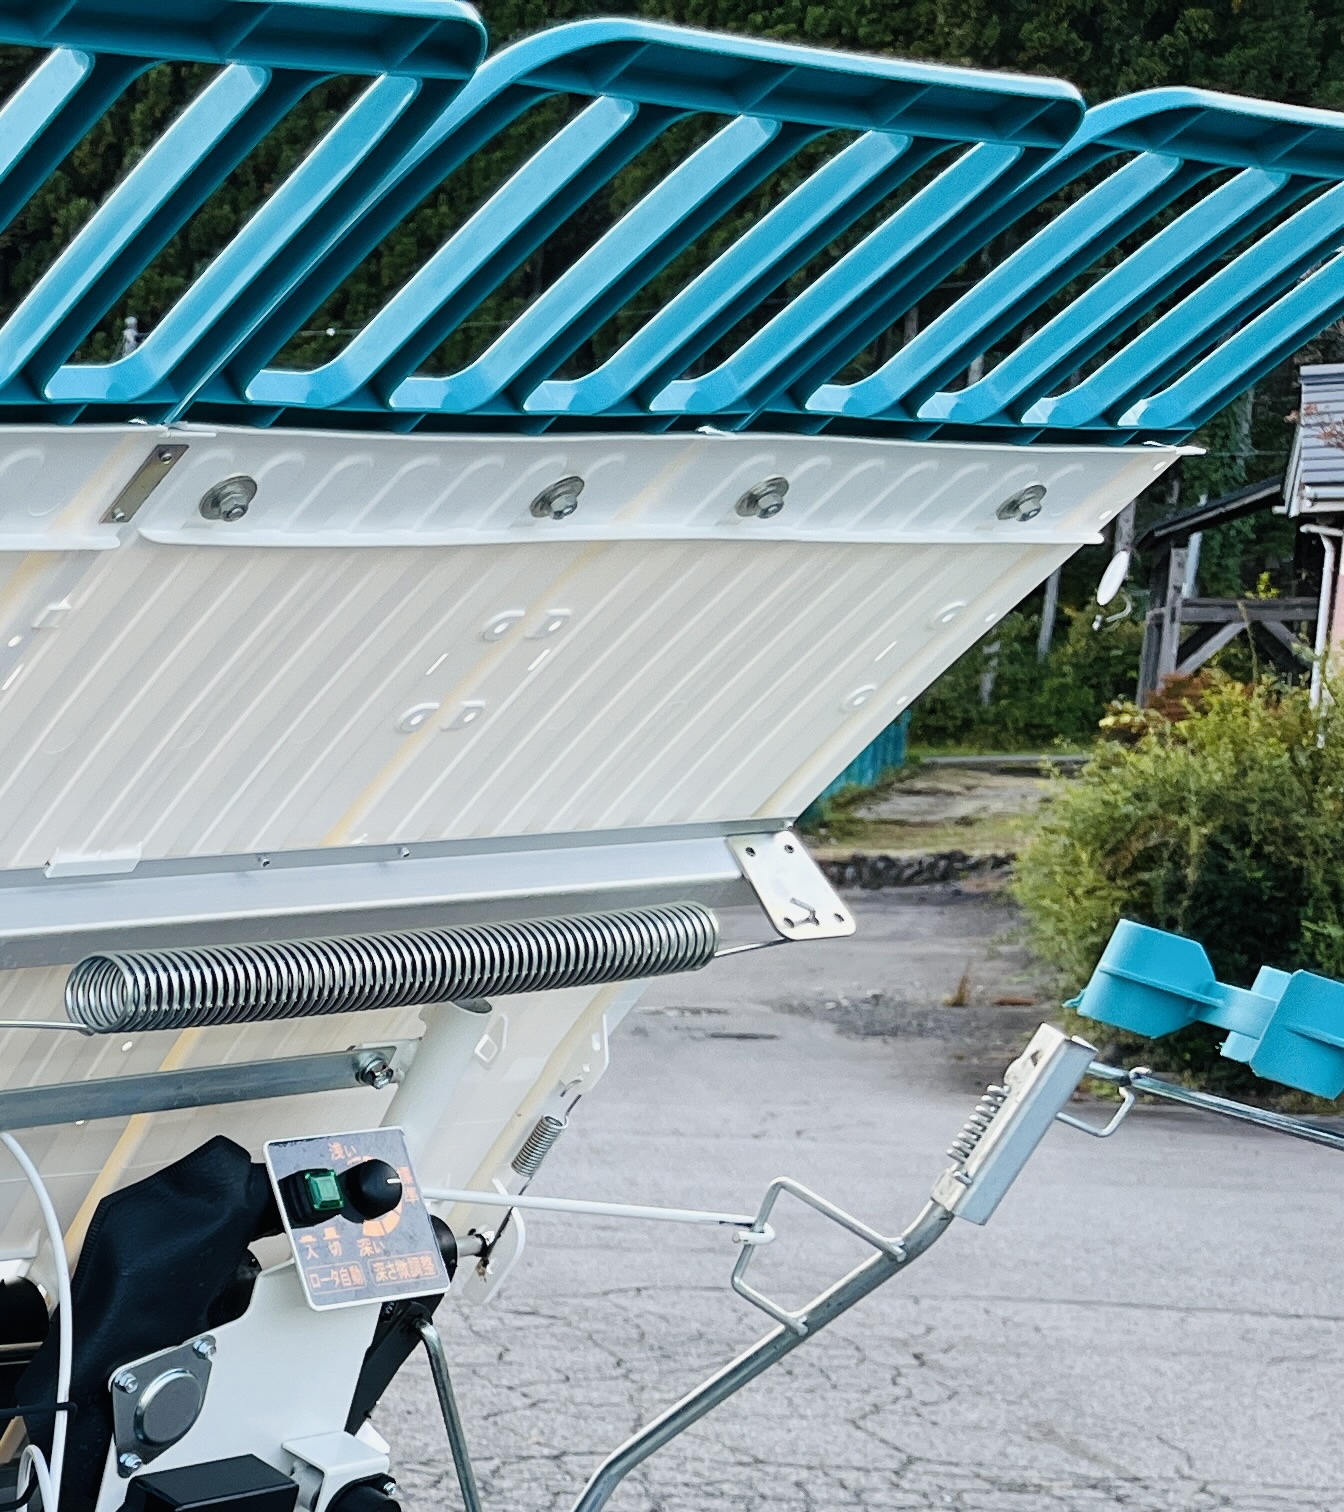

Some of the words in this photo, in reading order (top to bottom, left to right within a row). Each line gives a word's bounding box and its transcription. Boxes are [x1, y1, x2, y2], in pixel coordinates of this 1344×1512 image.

[329, 1143, 357, 1160] 浅い
[306, 1245, 319, 1259] 入
[329, 1241, 343, 1256] 切
[359, 1239, 385, 1256] 深い
[374, 1256, 435, 1281] 深さ微調整
[312, 1268, 364, 1288] ロータ自動
